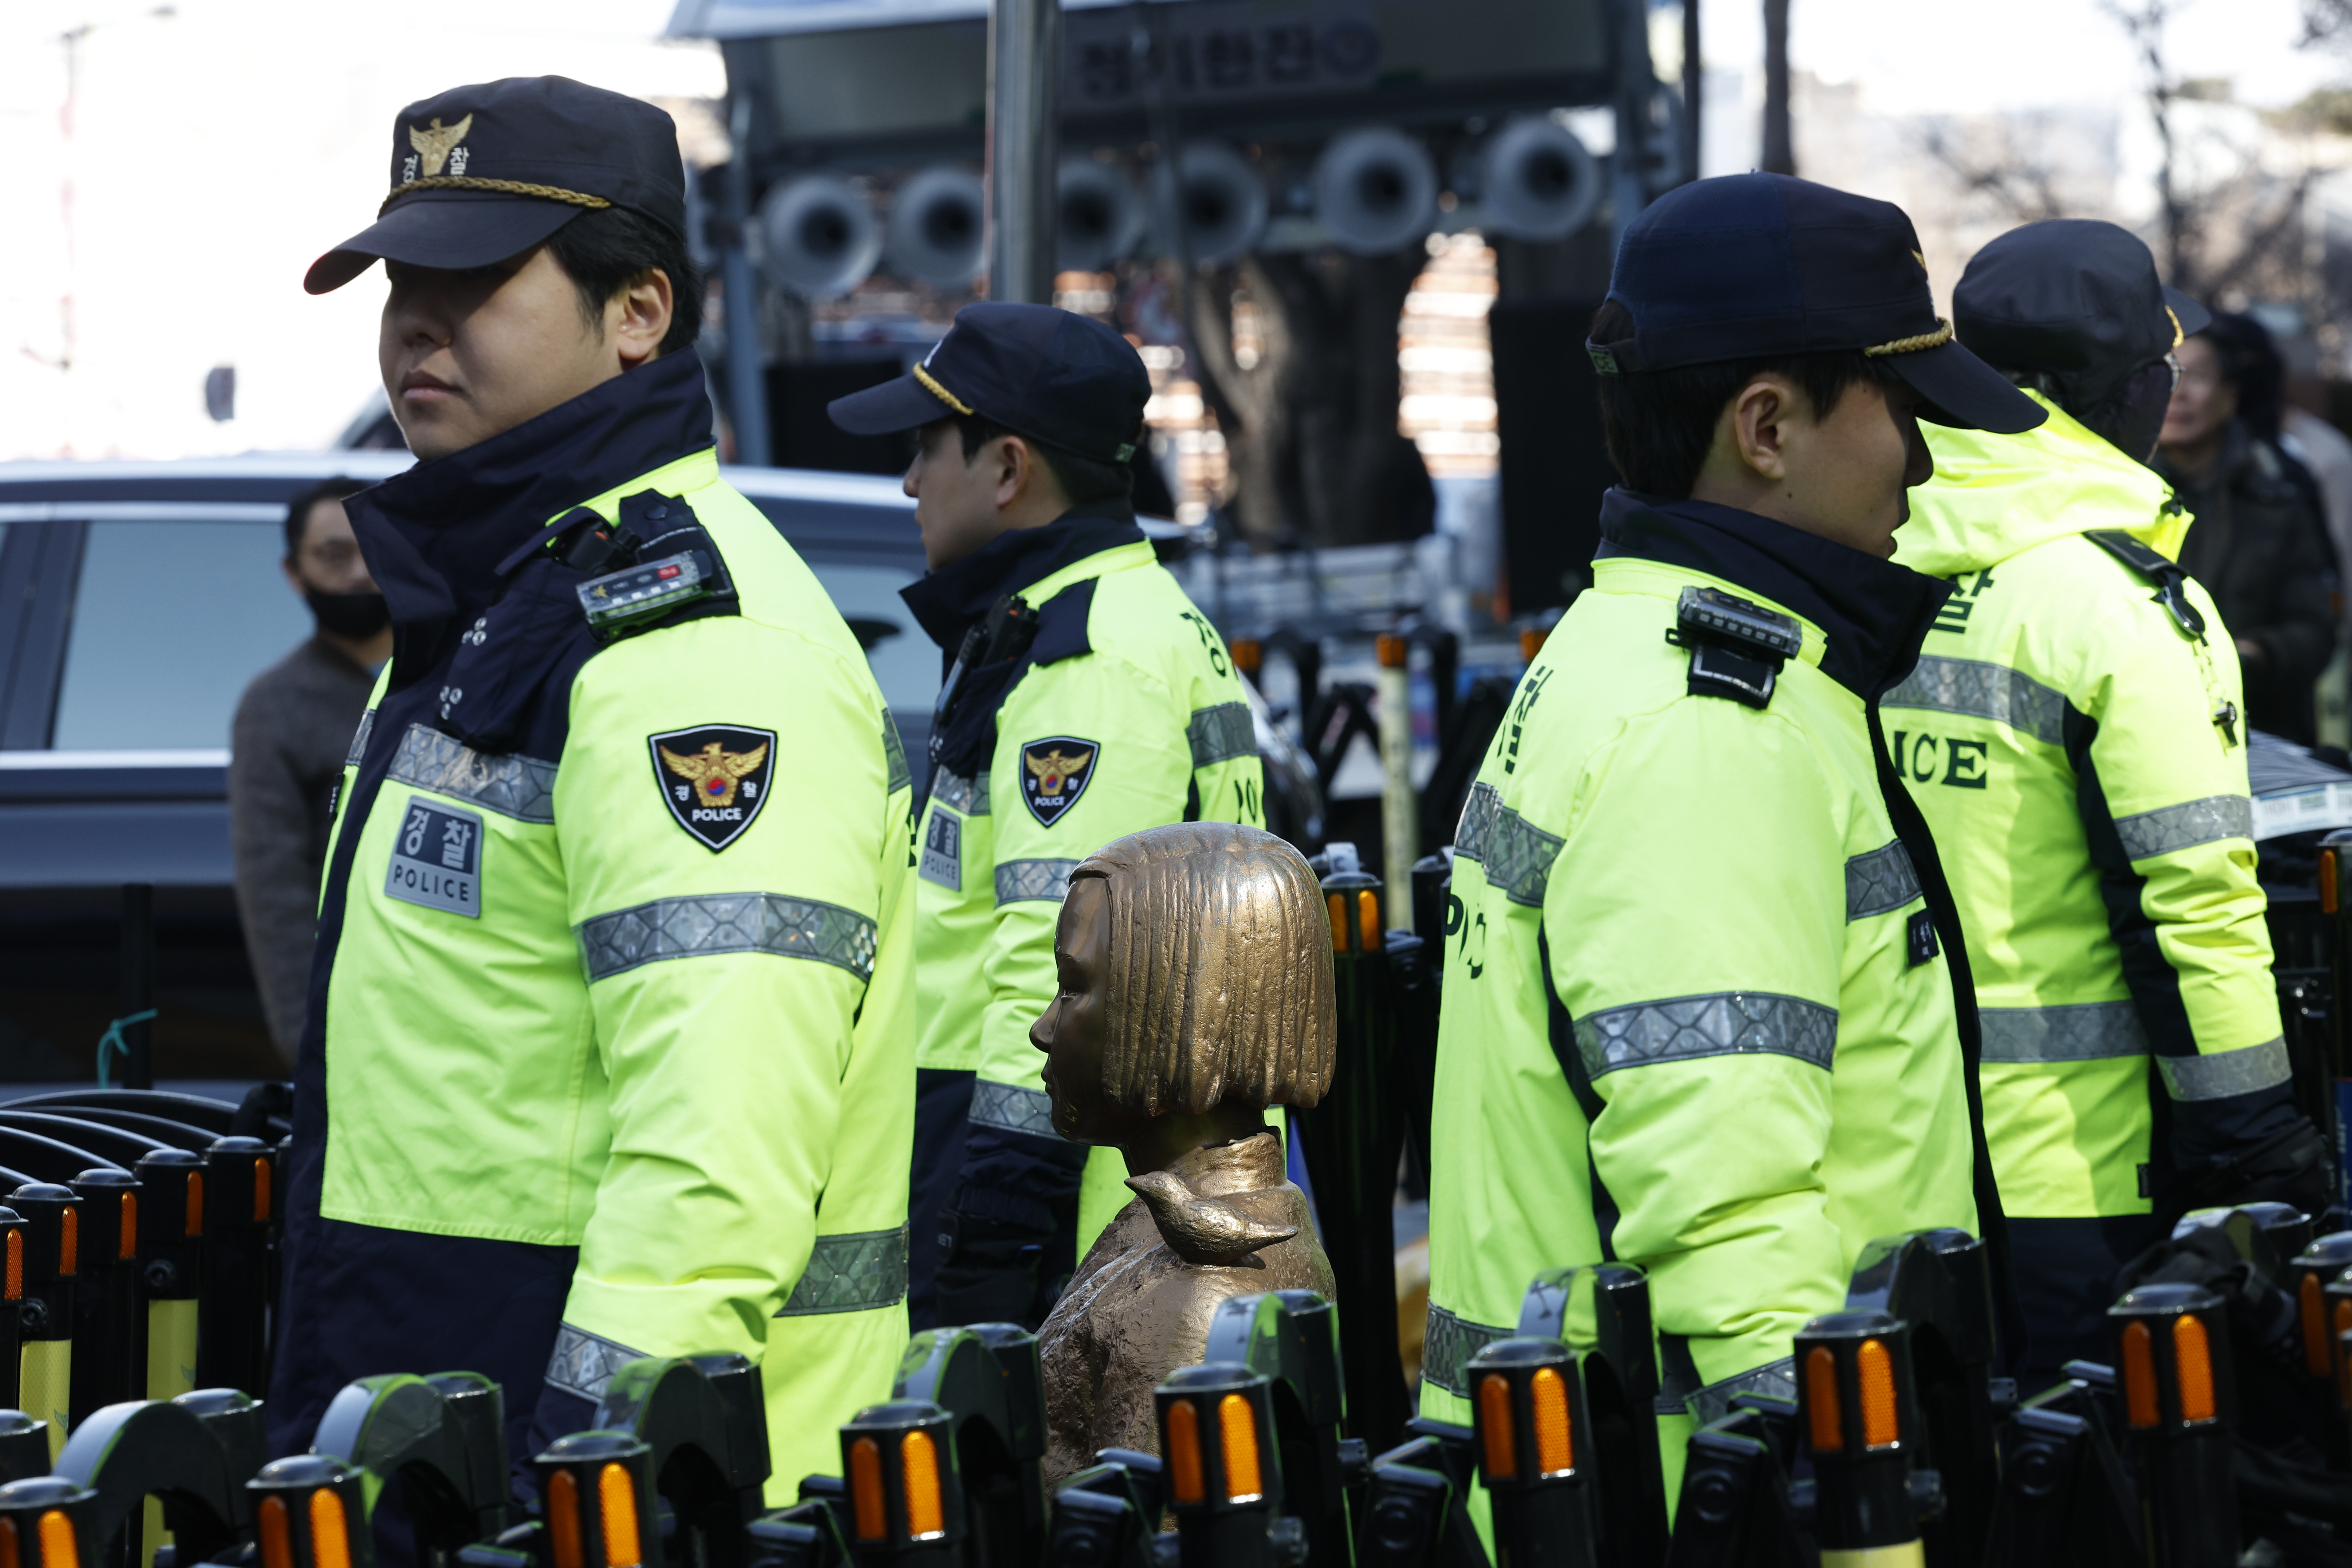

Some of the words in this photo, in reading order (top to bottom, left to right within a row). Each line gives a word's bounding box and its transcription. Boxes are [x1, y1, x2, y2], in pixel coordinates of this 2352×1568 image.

[403, 154, 418, 183] 경
[450, 146, 470, 175] 찰
[674, 784, 690, 801] 경
[692, 808, 742, 822] POLICE
[394, 864, 468, 902] POLICE
